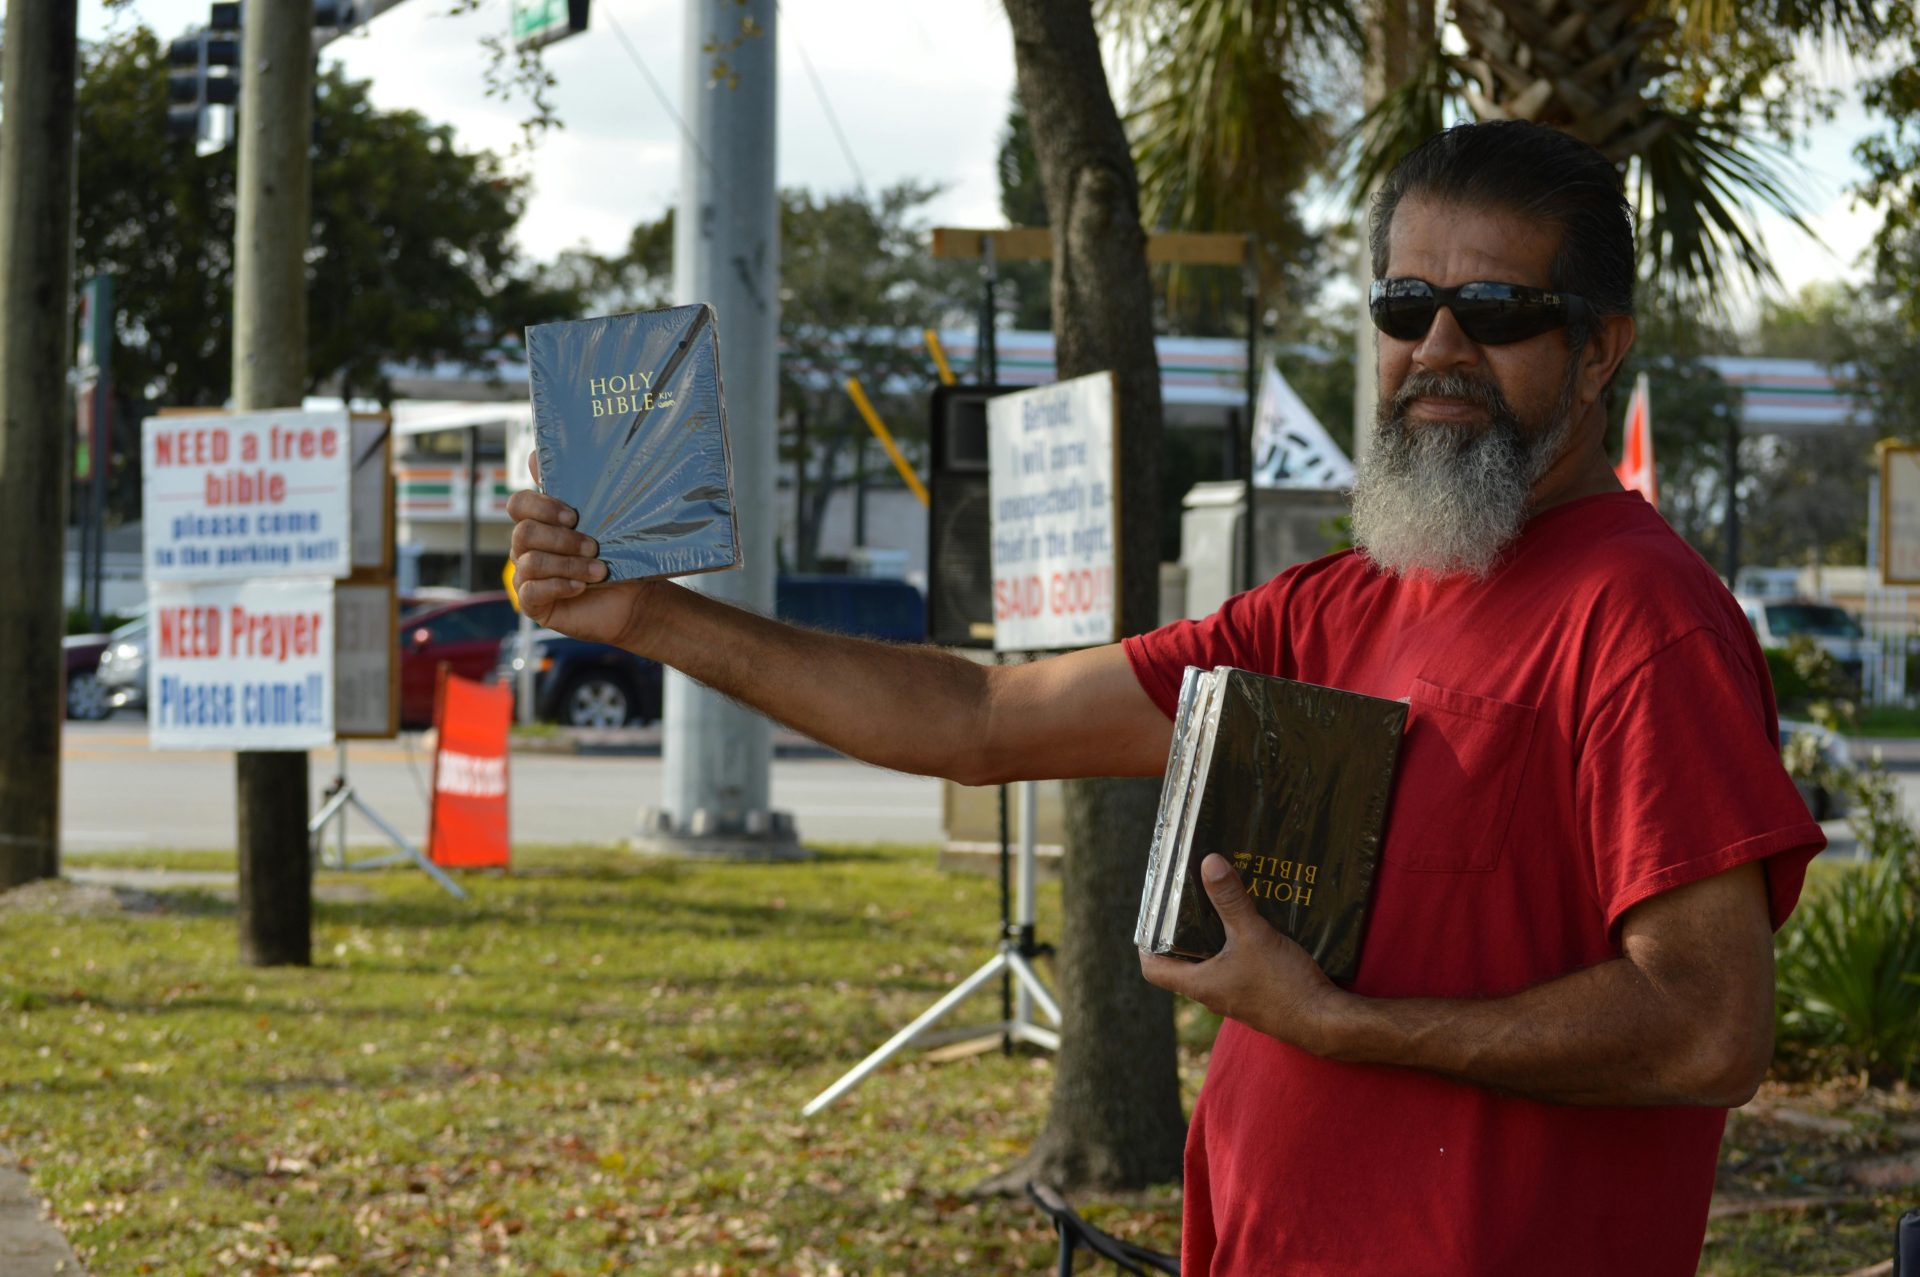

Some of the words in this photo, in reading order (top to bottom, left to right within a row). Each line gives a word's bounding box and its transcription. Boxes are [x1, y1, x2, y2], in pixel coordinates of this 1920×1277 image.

[590, 371, 654, 396] HOLY
[592, 392, 655, 417] BIBLE
[659, 391, 674, 400] KJV
[155, 429, 230, 467] NEED
[240, 432, 258, 463] a
[270, 425, 339, 459] free
[1051, 442, 1087, 470] come
[205, 470, 287, 507] bible
[173, 512, 248, 541] please
[258, 511, 320, 533] come
[180, 545, 209, 566] the
[217, 543, 291, 567] parking
[995, 573, 1044, 621] SAID
[158, 607, 221, 659] NEED
[229, 605, 322, 663] Prayer
[160, 674, 235, 727] Please
[244, 672, 324, 727] come!!
[1233, 861, 1248, 870] KJV
[1253, 855, 1318, 884] BIBLE
[1246, 877, 1313, 906] HOLY
